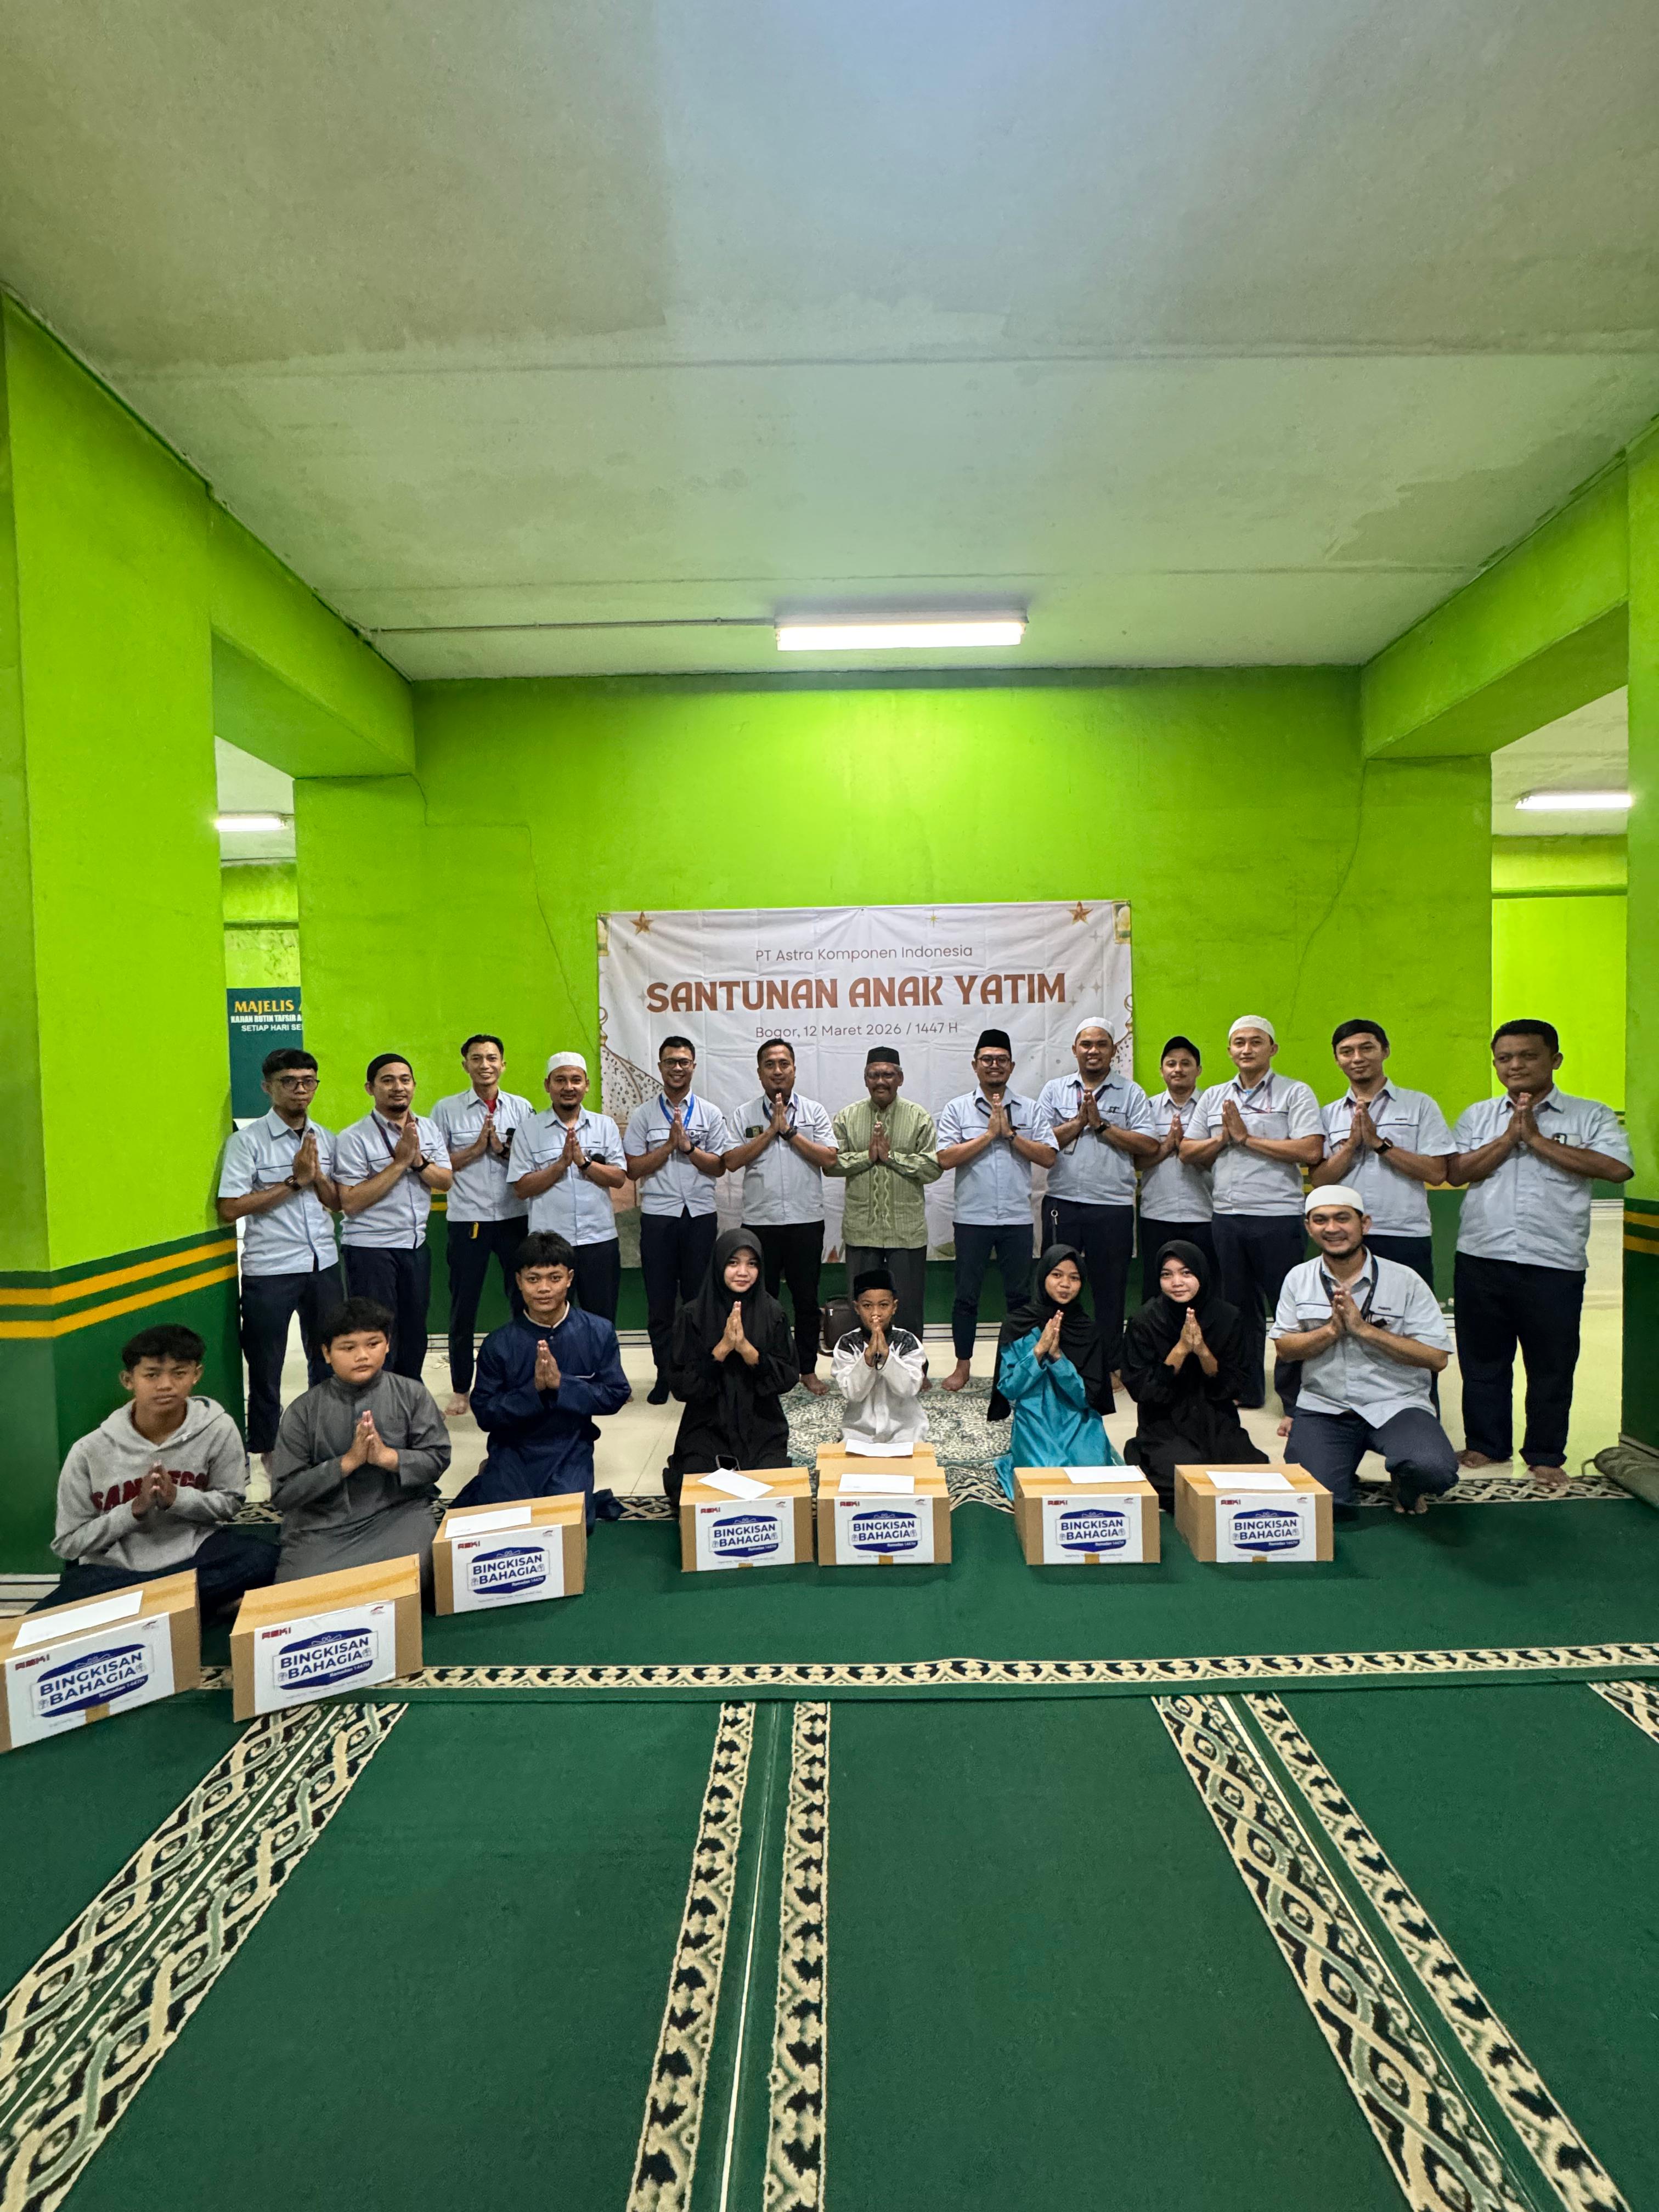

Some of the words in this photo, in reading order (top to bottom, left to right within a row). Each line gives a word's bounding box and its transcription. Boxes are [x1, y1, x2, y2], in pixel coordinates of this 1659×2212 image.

[756, 950, 771, 962] PT
[776, 949, 813, 961] Astra
[818, 948, 897, 963] Komponen
[902, 945, 973, 958] Indonesia
[646, 978, 838, 1013] SANTUNAN
[849, 976, 943, 1008] ANAK
[953, 973, 1066, 1006] YATIM
[234, 1000, 295, 1015] MAJELIS
[755, 1026, 800, 1040] Bogor,
[804, 1026, 817, 1036] 12
[822, 1025, 862, 1036] Maret
[866, 1023, 901, 1035] 2026
[906, 1022, 911, 1034] /
[915, 1023, 944, 1034] 1447
[949, 1022, 957, 1033] H
[714, 1523, 775, 1538] BINGKISAN
[853, 1520, 915, 1532] BINGKISAN
[1061, 1519, 1123, 1531] BINGKISAN
[1234, 1519, 1297, 1531] BINGKISAN
[719, 1533, 771, 1547] BAHAGIA
[859, 1530, 911, 1541] BAHAGIA
[1066, 1528, 1119, 1540] BAHAGIA
[1239, 1529, 1293, 1540] BAHAGIA
[473, 1554, 542, 1575] BINGKISAN
[479, 1565, 538, 1584] BAHAGIA
[280, 1637, 369, 1669] BINGKISAN
[288, 1650, 363, 1679] BAHAGIA
[40, 1652, 142, 1696] BINGKISAN
[50, 1666, 136, 1706] BAHAGIA
